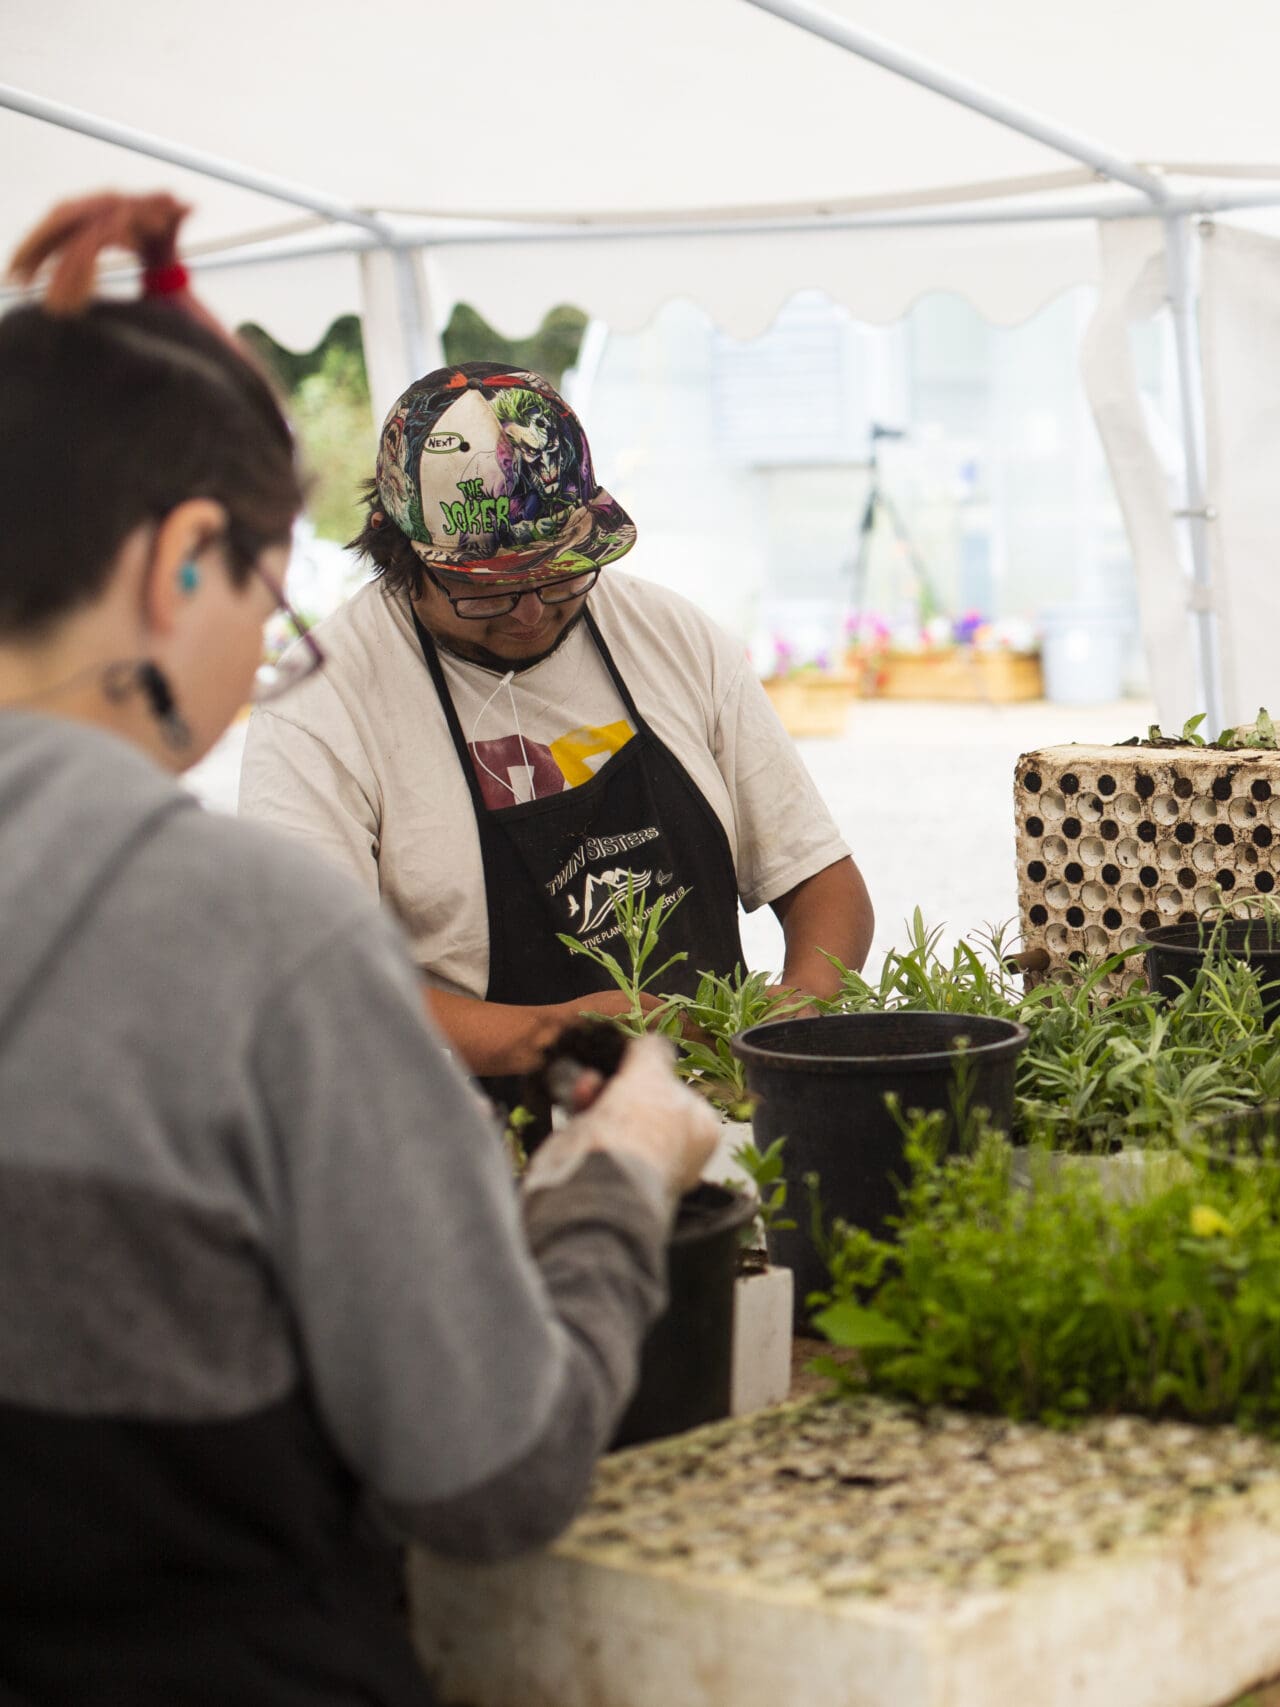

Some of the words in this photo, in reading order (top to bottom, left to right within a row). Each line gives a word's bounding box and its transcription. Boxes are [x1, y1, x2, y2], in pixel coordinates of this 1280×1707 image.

[456, 477, 483, 500] THE
[439, 495, 510, 535] JOKER
[545, 845, 585, 896] TWIN
[586, 827, 659, 860] SISTERS
[568, 934, 602, 956] NTIVE
